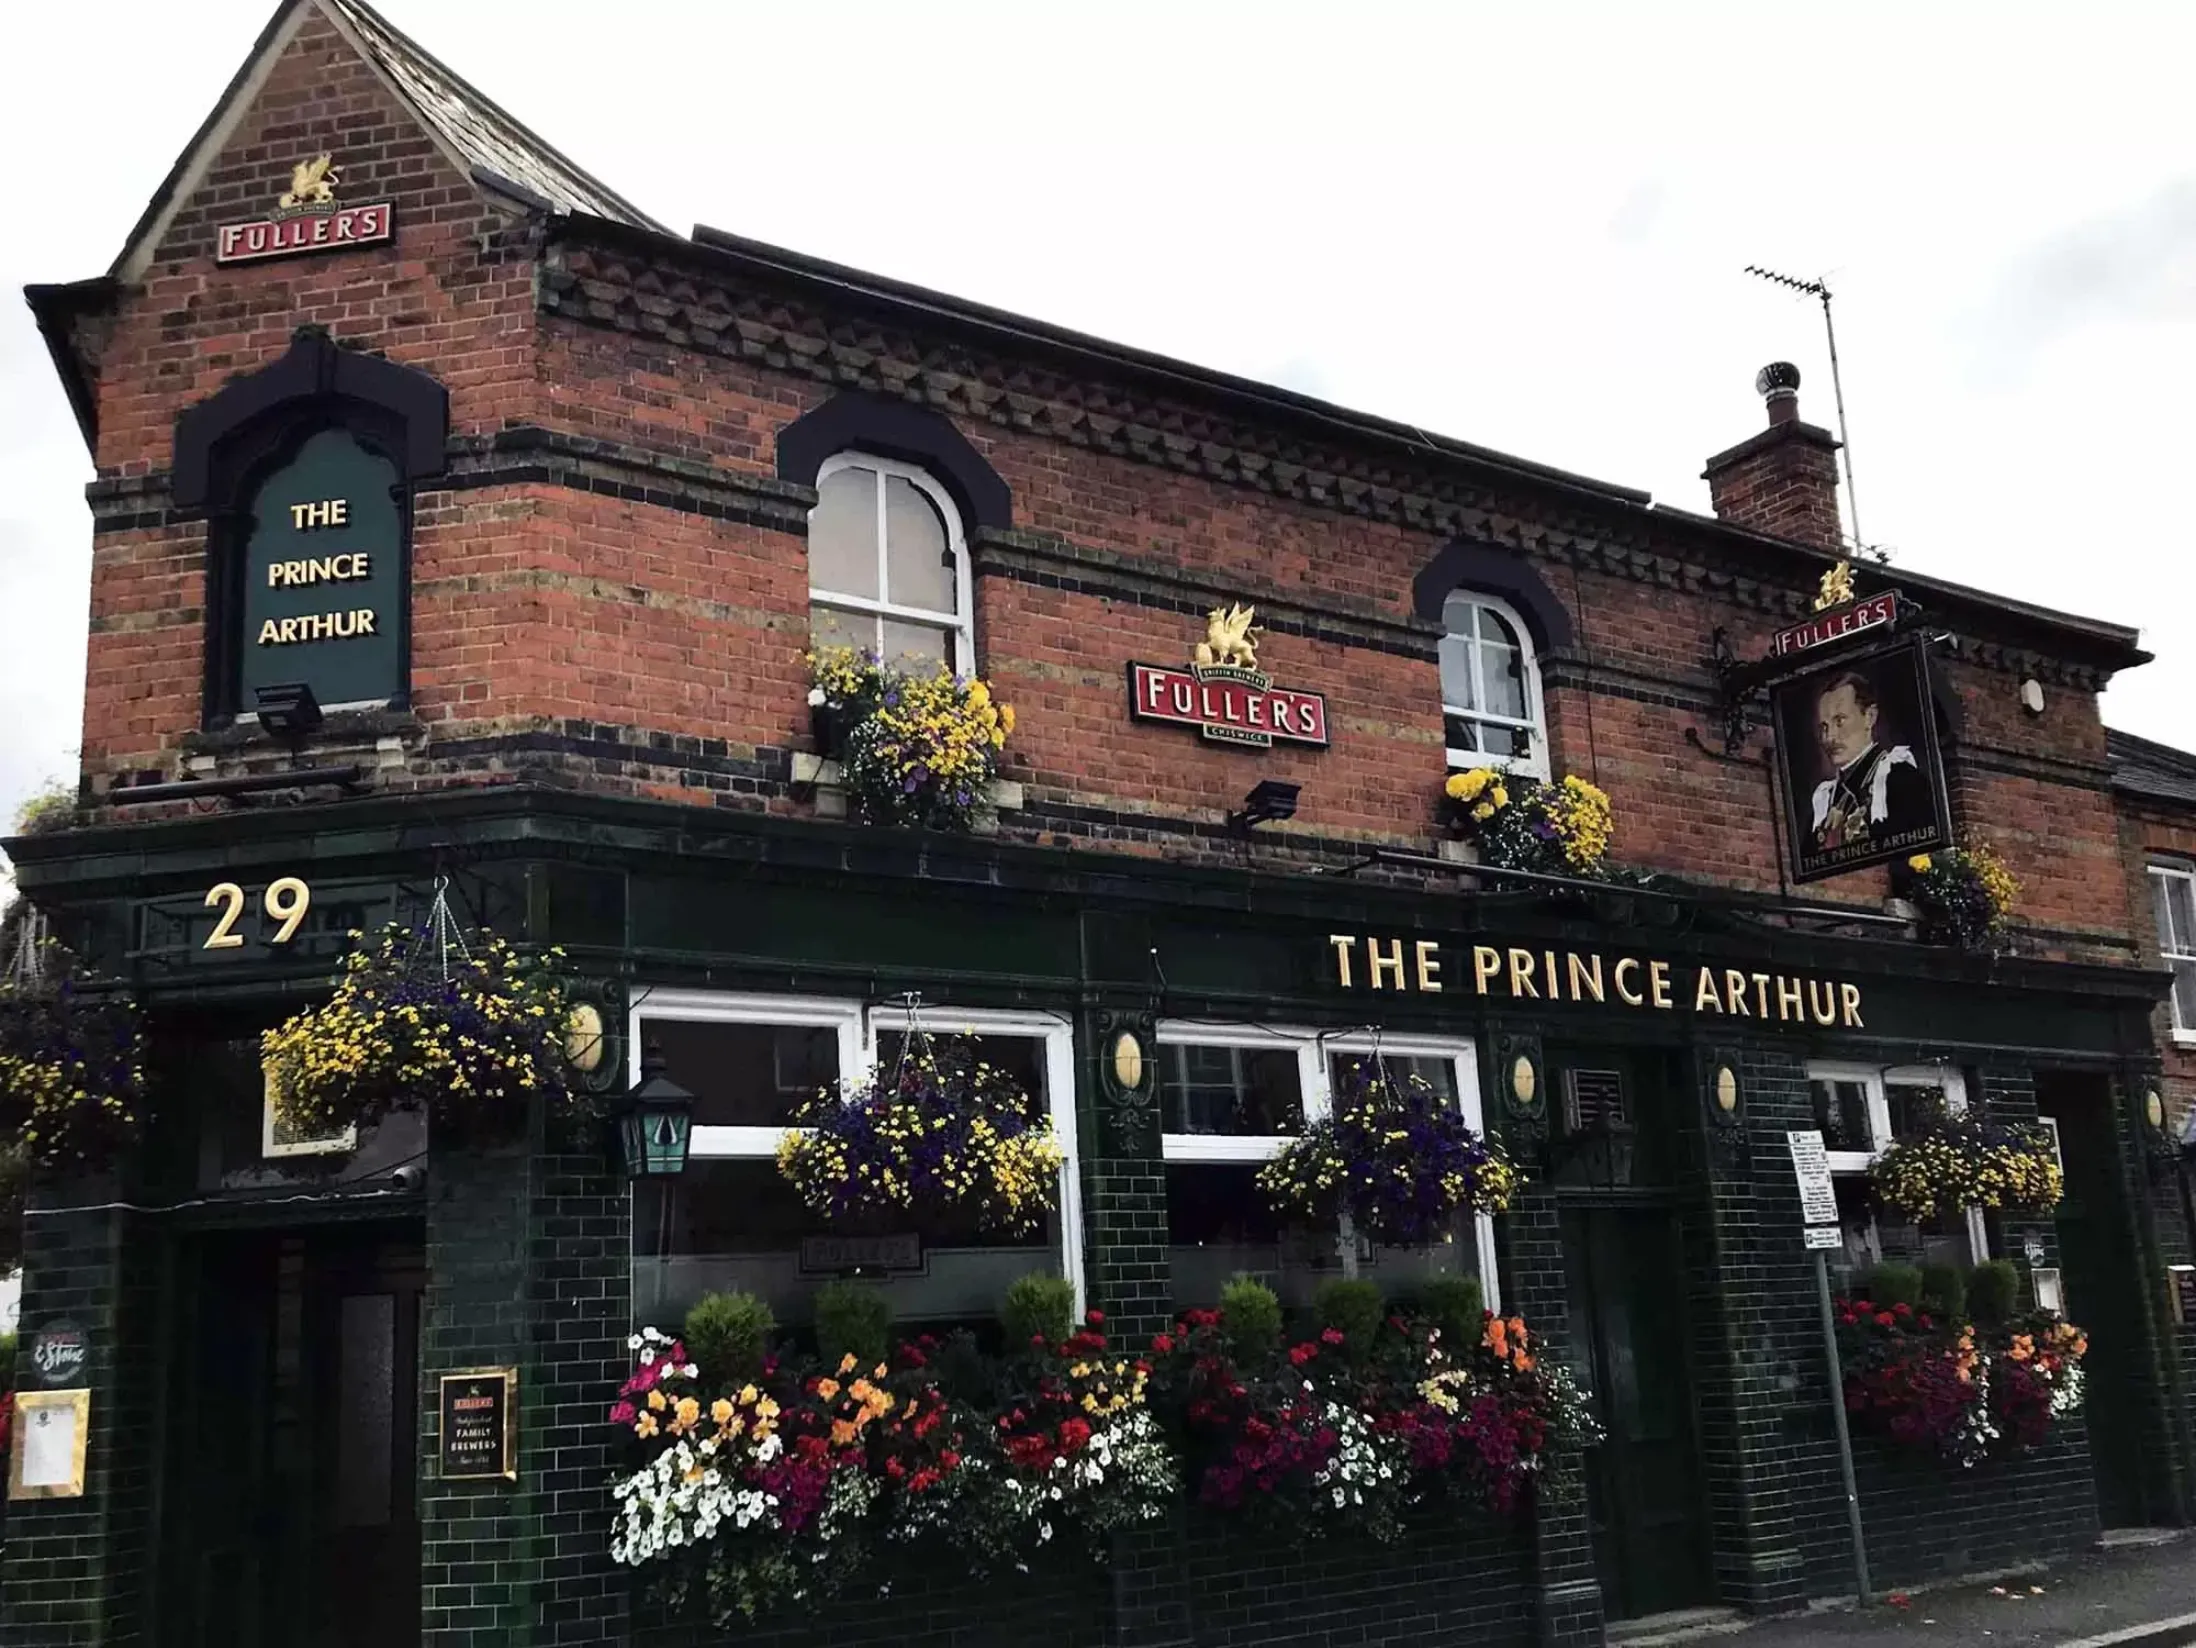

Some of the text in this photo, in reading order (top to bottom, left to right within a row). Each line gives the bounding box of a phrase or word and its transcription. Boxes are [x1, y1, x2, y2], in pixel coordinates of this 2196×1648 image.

[224, 210, 378, 253] FULLER'S
[290, 499, 347, 529] THE
[268, 552, 369, 587] PRINCE
[258, 608, 375, 644] ARTHUR
[1782, 601, 1887, 653] FULLER'S
[1148, 671, 1316, 734] FULLER'S
[1211, 726, 1264, 742] CHISWICK
[1803, 825, 1937, 870] THE PRINCE ARTHUR
[202, 877, 310, 949] 29
[1330, 934, 1865, 1028] THE PRINCE ARTHUR
[450, 1440, 497, 1451] BREWERS
[456, 1428, 492, 1438] FAMILY
